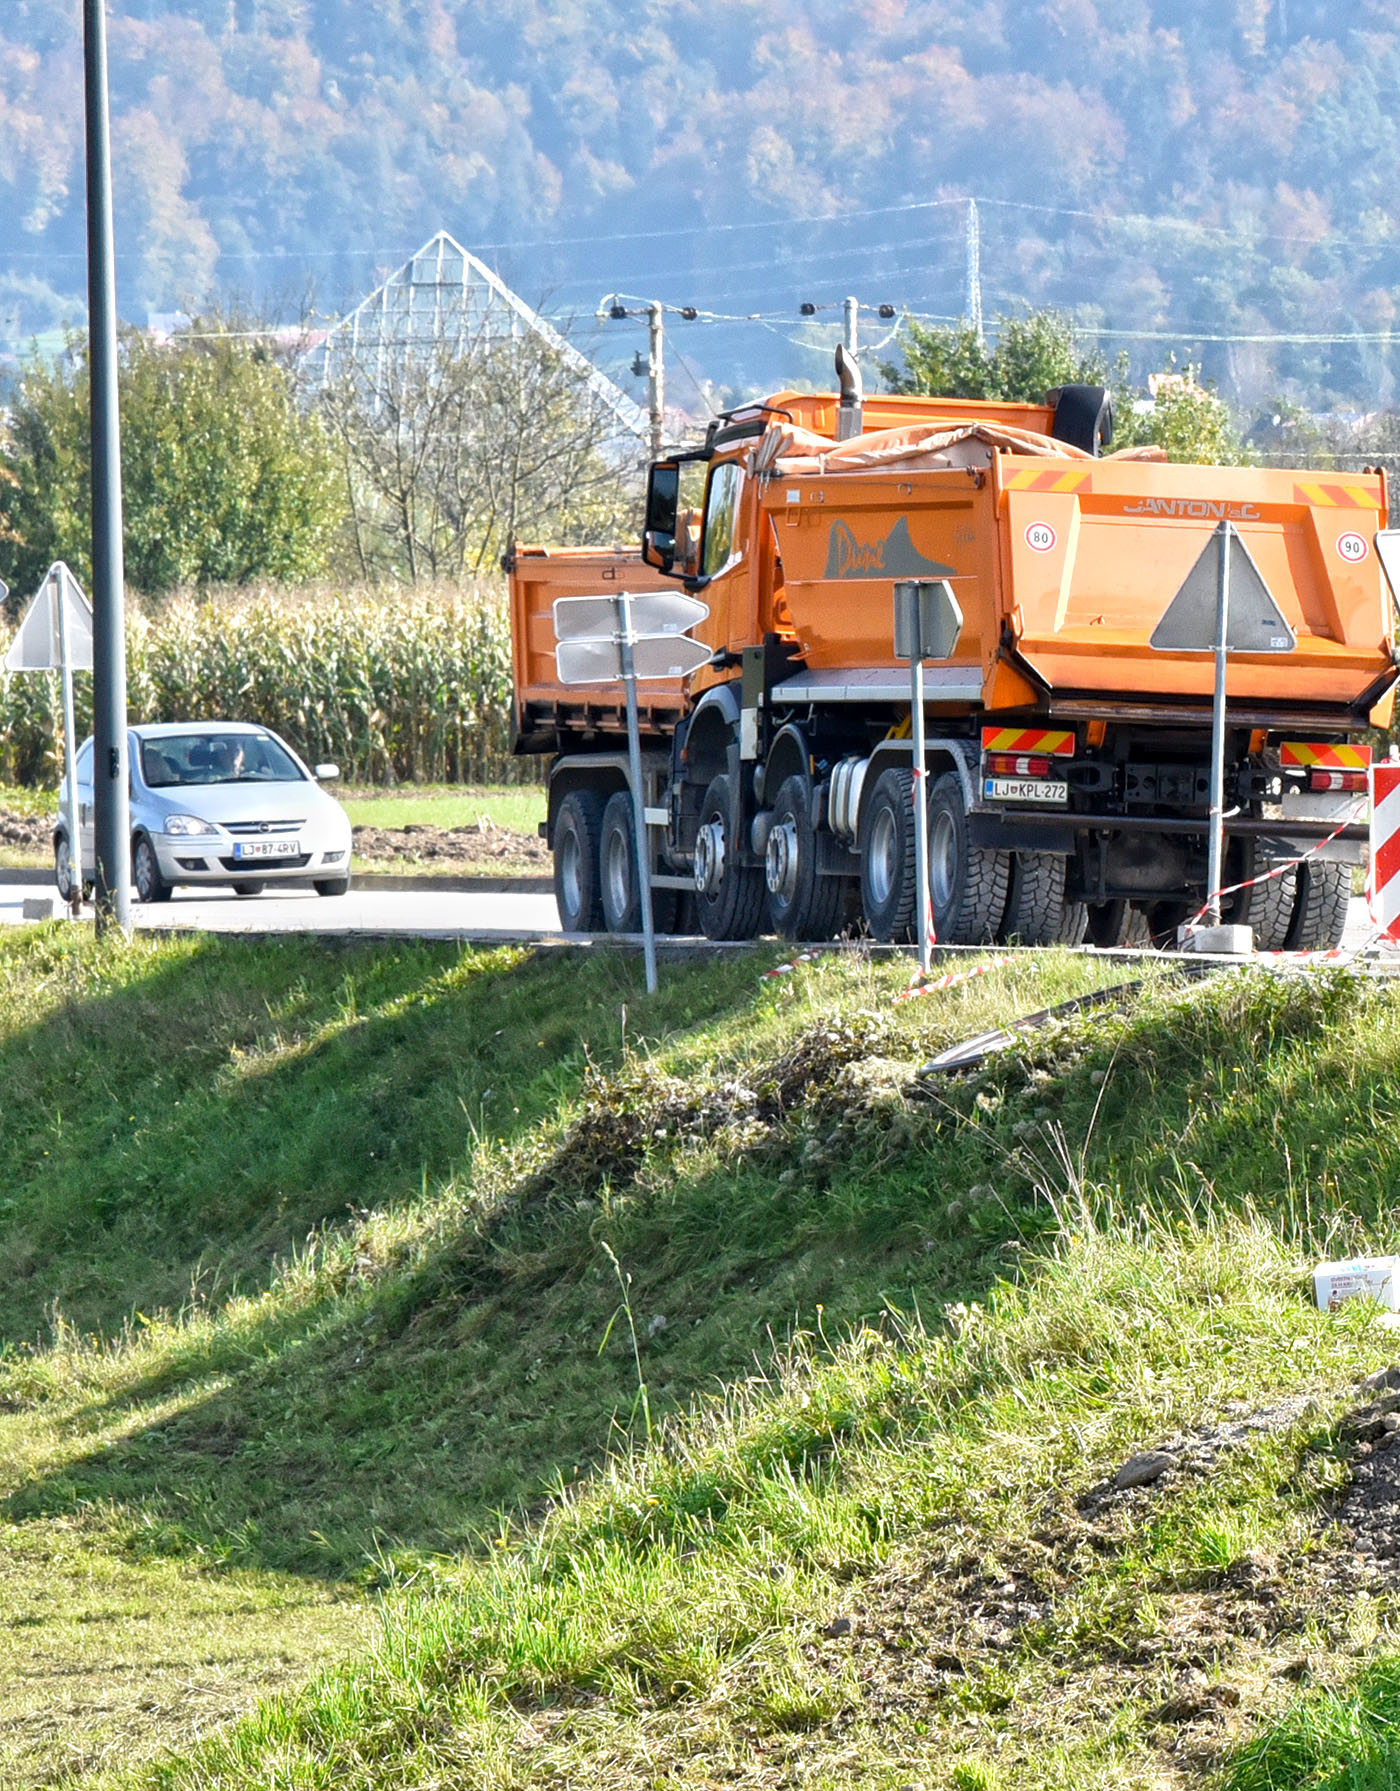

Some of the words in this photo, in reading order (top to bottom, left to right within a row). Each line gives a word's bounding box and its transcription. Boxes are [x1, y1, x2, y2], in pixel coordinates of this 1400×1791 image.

[1033, 531, 1049, 543] 80
[1345, 541, 1360, 553] 90
[994, 782, 1010, 796] LJ
